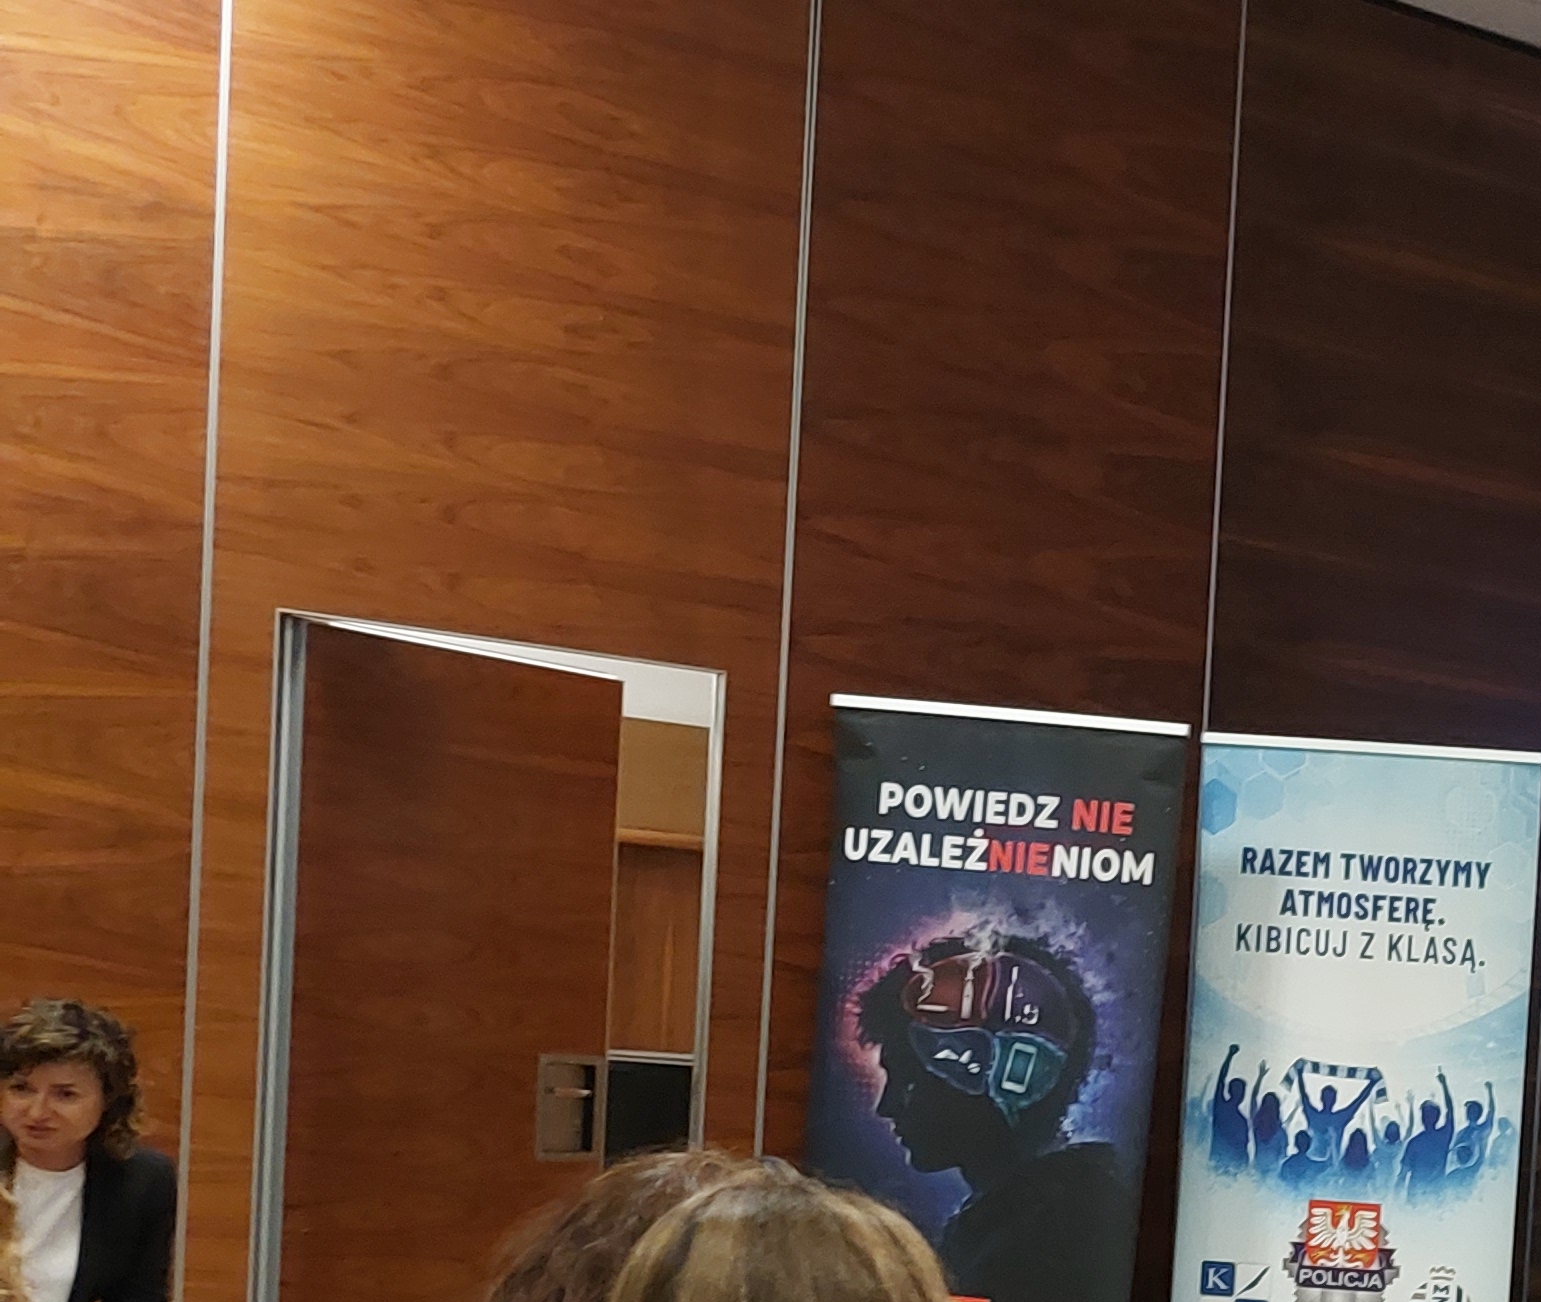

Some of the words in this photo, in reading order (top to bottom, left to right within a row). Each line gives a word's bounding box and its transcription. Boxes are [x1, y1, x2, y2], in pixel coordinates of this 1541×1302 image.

[878, 781, 1061, 829] POWIEDZ
[1071, 798, 1135, 836] NIE
[843, 827, 1155, 886] UZALEŻNIENIOM
[1240, 846, 1331, 879] RAZEM
[1340, 852, 1492, 889] TWORZYMY
[1279, 888, 1445, 932] ATMOSFERĘ.
[1235, 923, 1348, 957] KIBICUJ
[1359, 932, 1376, 959] Z
[1387, 933, 1486, 975] KLASĄ.
[1207, 1267, 1230, 1290] K
[1299, 1268, 1384, 1290] POLICJA
